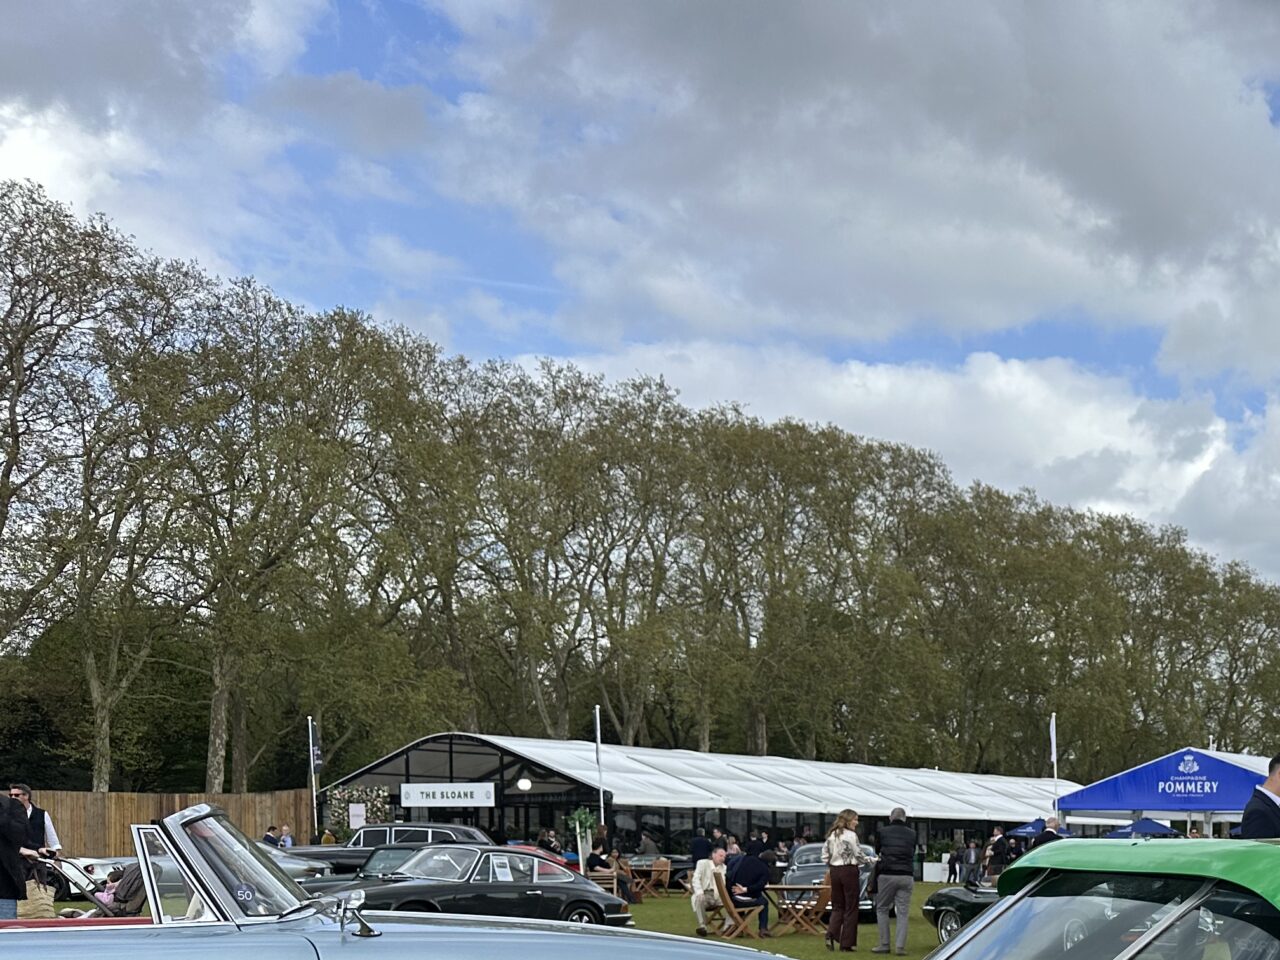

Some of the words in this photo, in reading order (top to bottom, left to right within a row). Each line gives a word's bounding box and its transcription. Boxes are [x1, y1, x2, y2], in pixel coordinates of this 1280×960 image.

[1158, 781, 1219, 793] POMMERY
[420, 791, 437, 799] THE
[440, 791, 475, 800] SLOANE
[237, 890, 253, 901] 50
